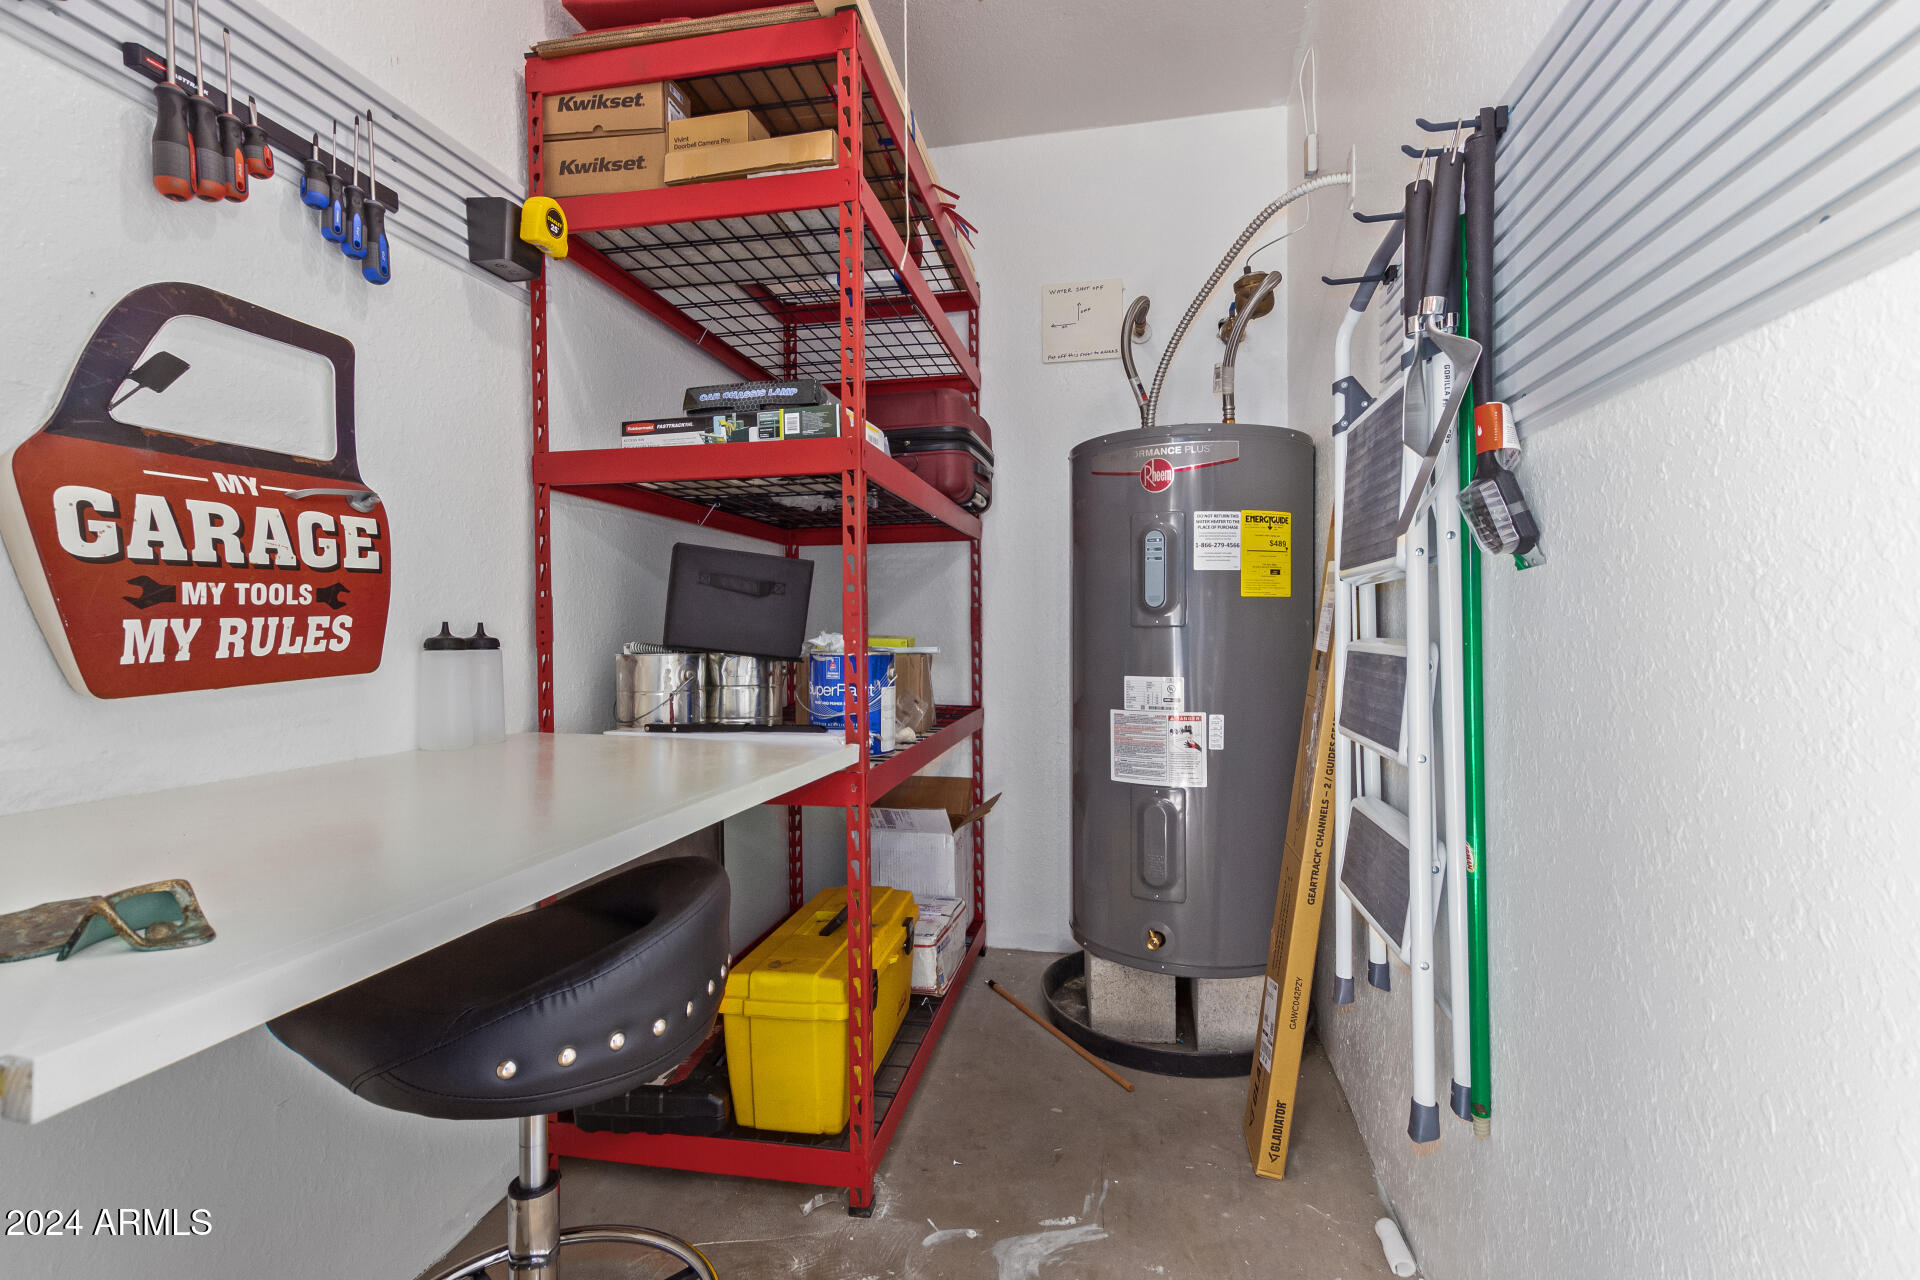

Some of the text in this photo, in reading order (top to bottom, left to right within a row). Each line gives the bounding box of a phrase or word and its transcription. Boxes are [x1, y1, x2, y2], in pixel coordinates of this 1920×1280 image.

[557, 92, 645, 112] Kwikset
[674, 141, 697, 150] Doorbell
[698, 139, 720, 147] Camera
[559, 155, 647, 176] Kwikset
[1443, 364, 1451, 396] GORILLA
[699, 387, 798, 401] CAR CHASSIS LAMP
[1184, 444, 1210, 454] PLUS
[212, 472, 258, 496] MY
[1143, 459, 1172, 487] Rheem
[53, 485, 382, 571] GARAGE
[1269, 539, 1287, 548] $489
[182, 582, 313, 606] MY TOOLS
[120, 615, 354, 665] MY RULES
[809, 682, 875, 698] SuperPat
[1307, 851, 1322, 905] GEARTRACK
[1316, 799, 1329, 848] CHANNELS
[1289, 977, 1303, 1030] GAWC042PZY
[1271, 1101, 1287, 1153] GLADIATOR
